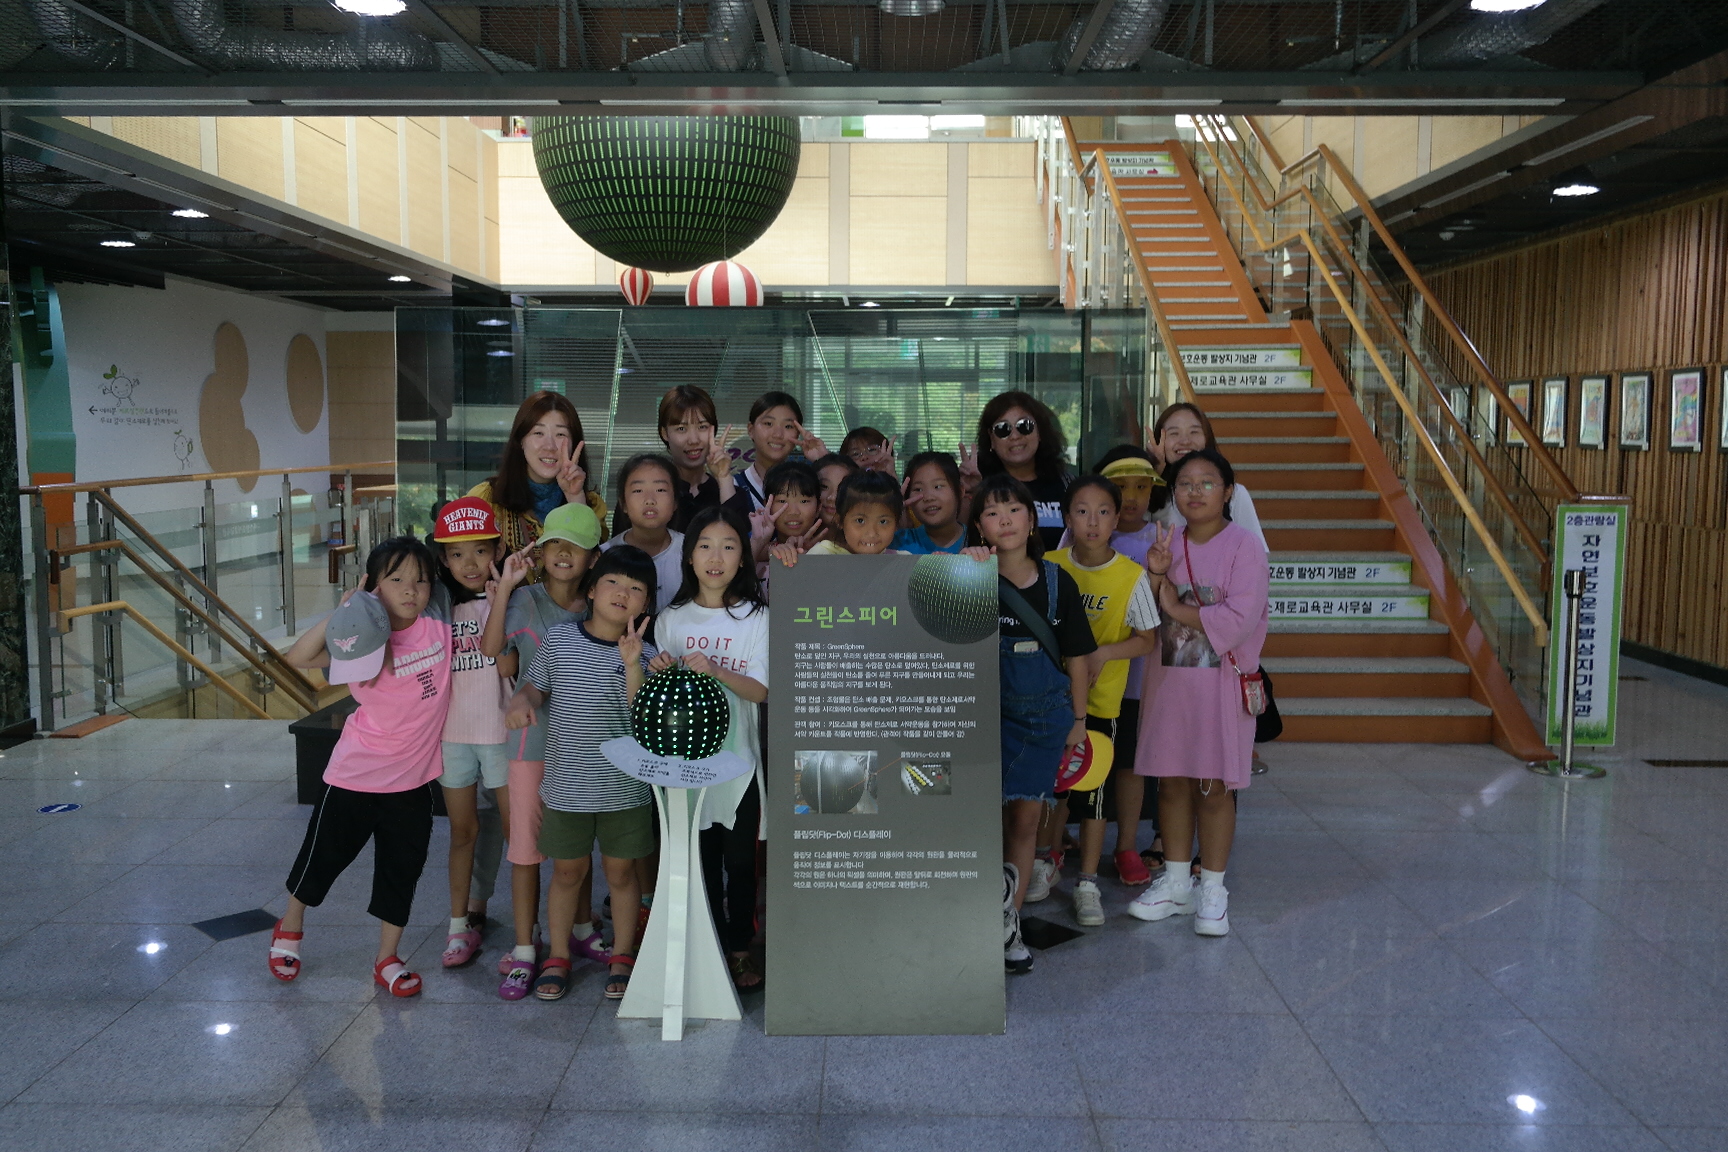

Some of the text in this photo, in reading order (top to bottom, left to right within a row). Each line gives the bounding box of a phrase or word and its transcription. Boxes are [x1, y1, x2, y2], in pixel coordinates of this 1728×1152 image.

[1210, 354, 1232, 364] 발상지
[1235, 354, 1258, 364] 기념관
[1264, 354, 1276, 362] 2F
[1240, 376, 1267, 386] 사무실
[1274, 376, 1286, 384] 2F
[443, 508, 489, 524] HEAVENLY
[1567, 515, 1616, 526] 2층관람실
[448, 520, 484, 532] GIANTS
[1298, 566, 1326, 580] 발상지
[1328, 566, 1356, 580] 기념관
[1366, 568, 1380, 578] 2F
[1338, 602, 1372, 614] 사무실
[1382, 602, 1397, 612] 2F
[794, 606, 896, 628] 그린스피어
[686, 636, 732, 650] DO IT
